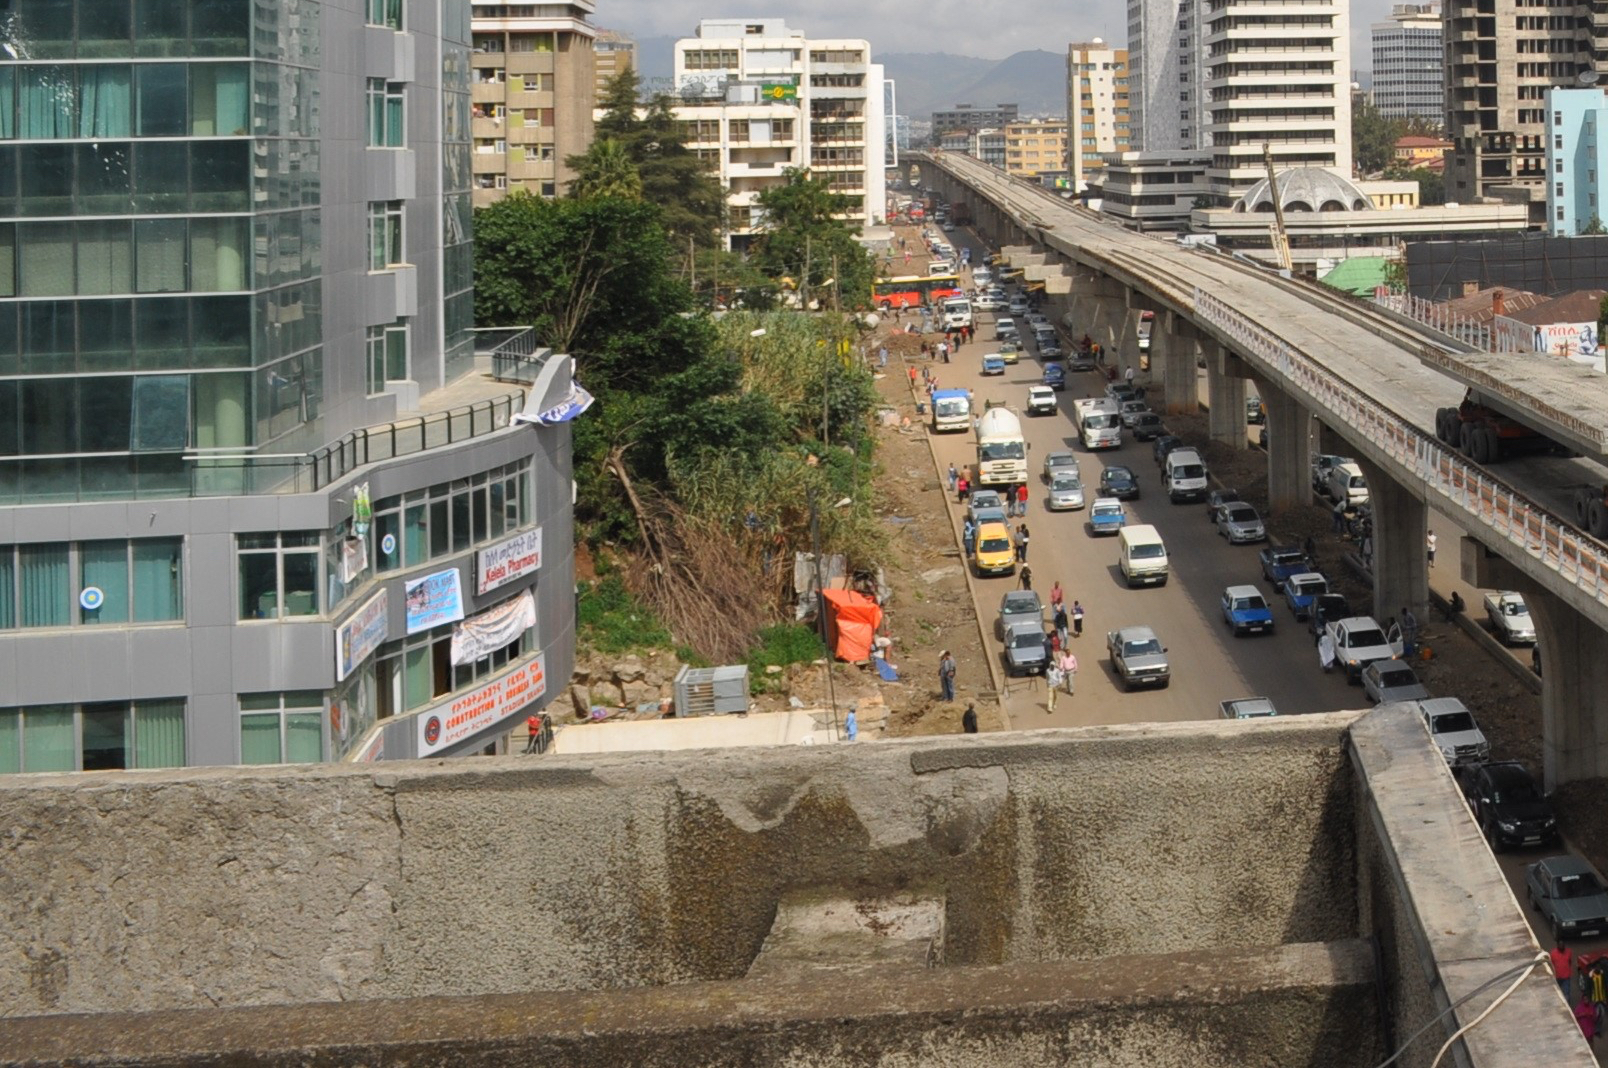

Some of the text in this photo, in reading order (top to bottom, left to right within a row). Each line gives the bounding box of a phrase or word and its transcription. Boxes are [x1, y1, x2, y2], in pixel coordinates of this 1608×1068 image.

[508, 552, 539, 574] Pharmacy
[445, 699, 495, 730] CONSTRUCTION
[500, 697, 525, 716] STADIUM
